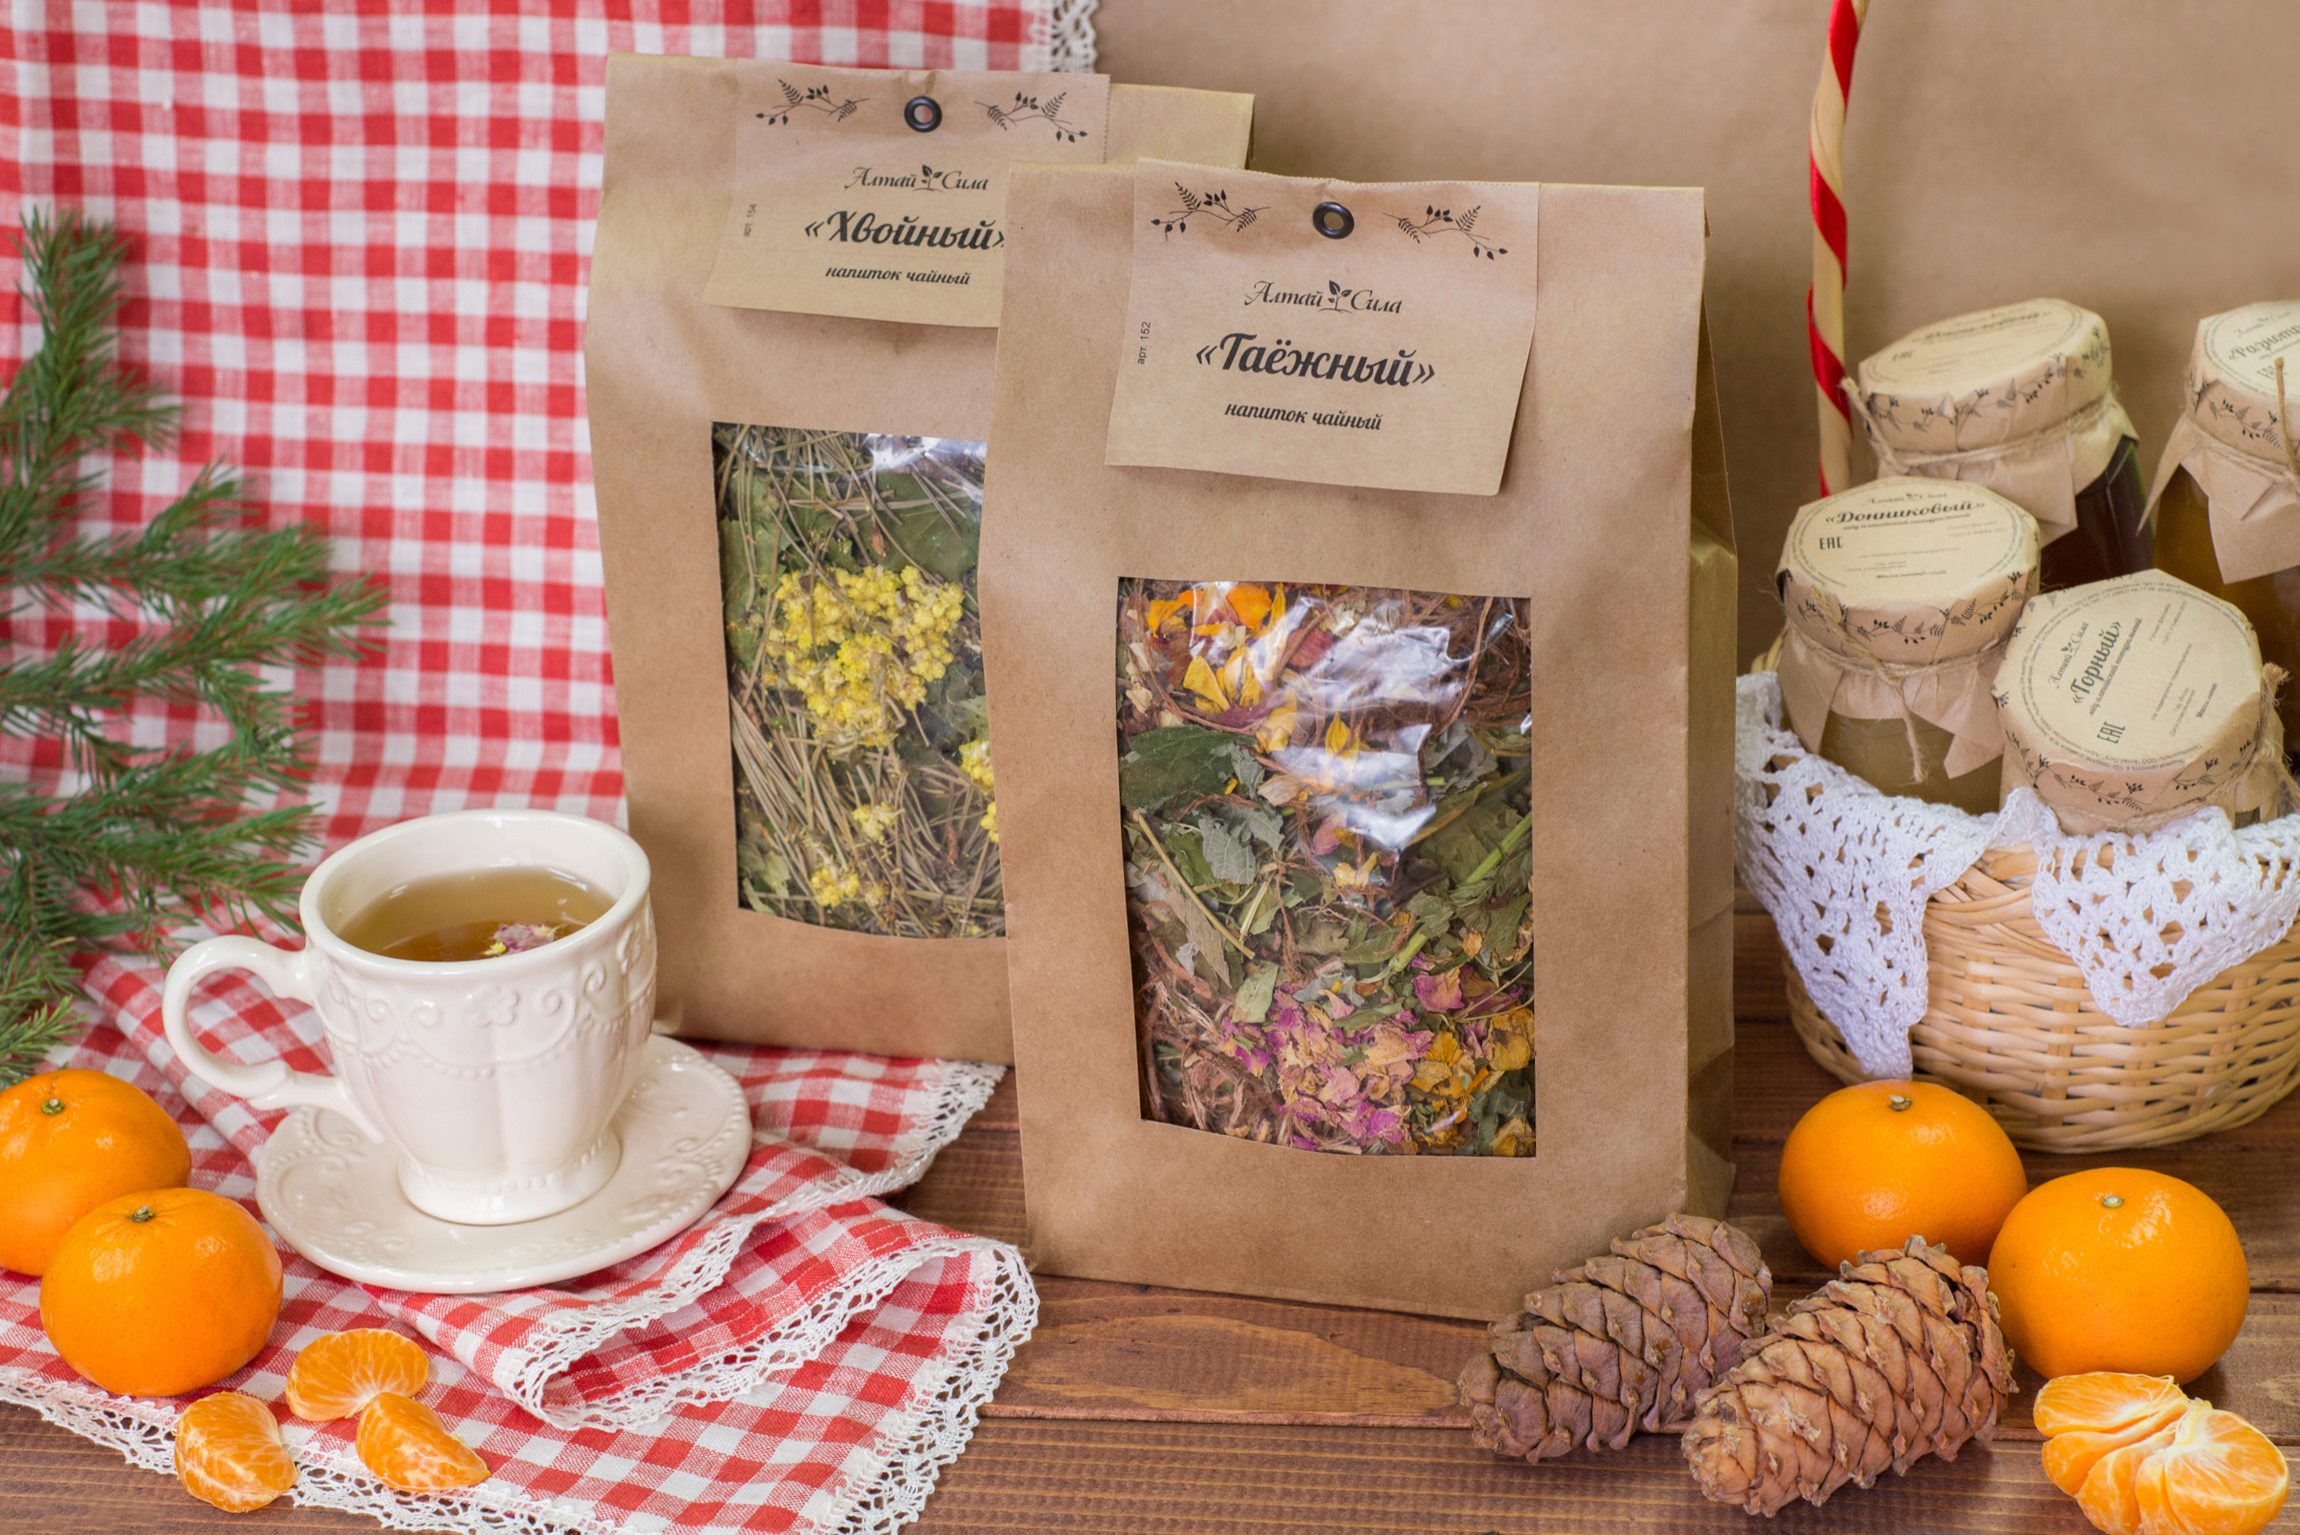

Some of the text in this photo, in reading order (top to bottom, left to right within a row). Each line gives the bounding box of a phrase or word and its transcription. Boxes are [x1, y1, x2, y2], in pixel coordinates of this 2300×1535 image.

[844, 167, 989, 190] Алтай Сила
[825, 267, 971, 286] напиток чайный
[1244, 281, 1403, 314] Алтай Сила
[1196, 333, 1435, 387] «Таёжный»
[1225, 404, 1382, 430] напиток чайный
